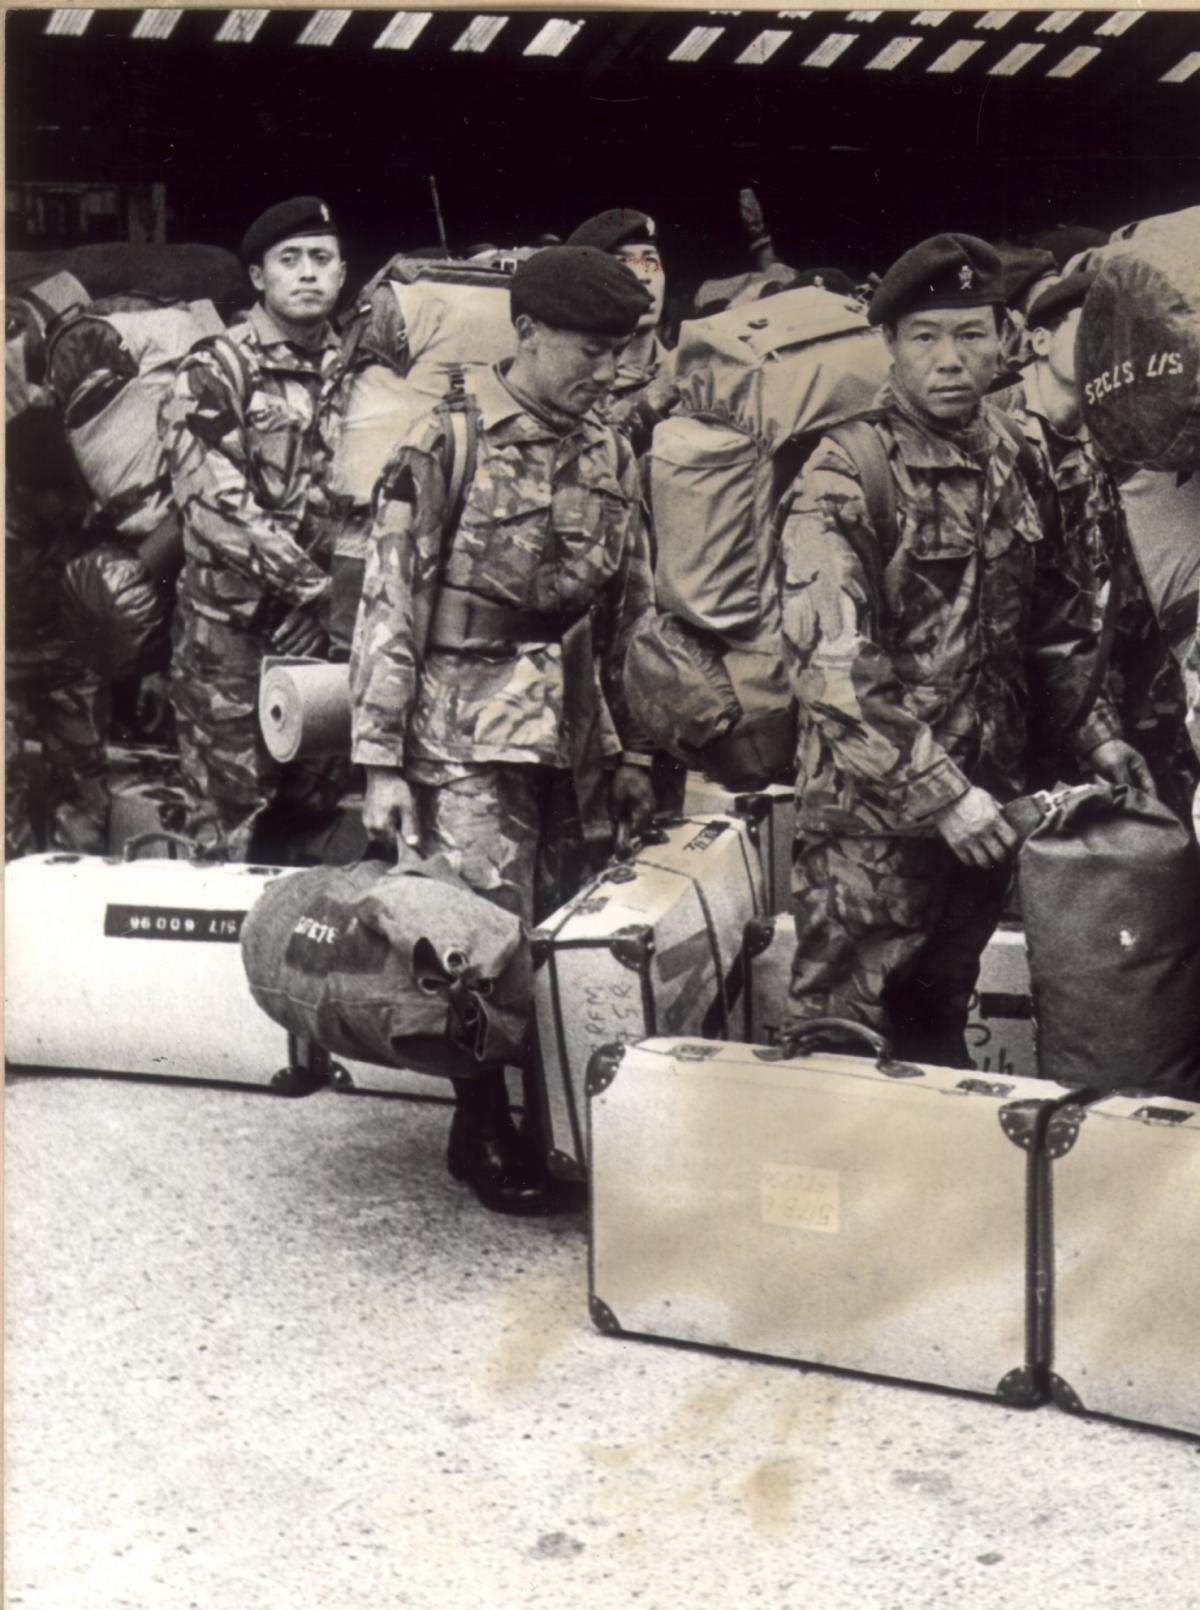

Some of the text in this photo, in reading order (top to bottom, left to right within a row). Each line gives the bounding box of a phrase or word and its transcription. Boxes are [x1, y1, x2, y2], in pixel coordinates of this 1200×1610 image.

[1085, 353, 1184, 405] 5/7 57325
[208, 919, 238, 934] 5/7
